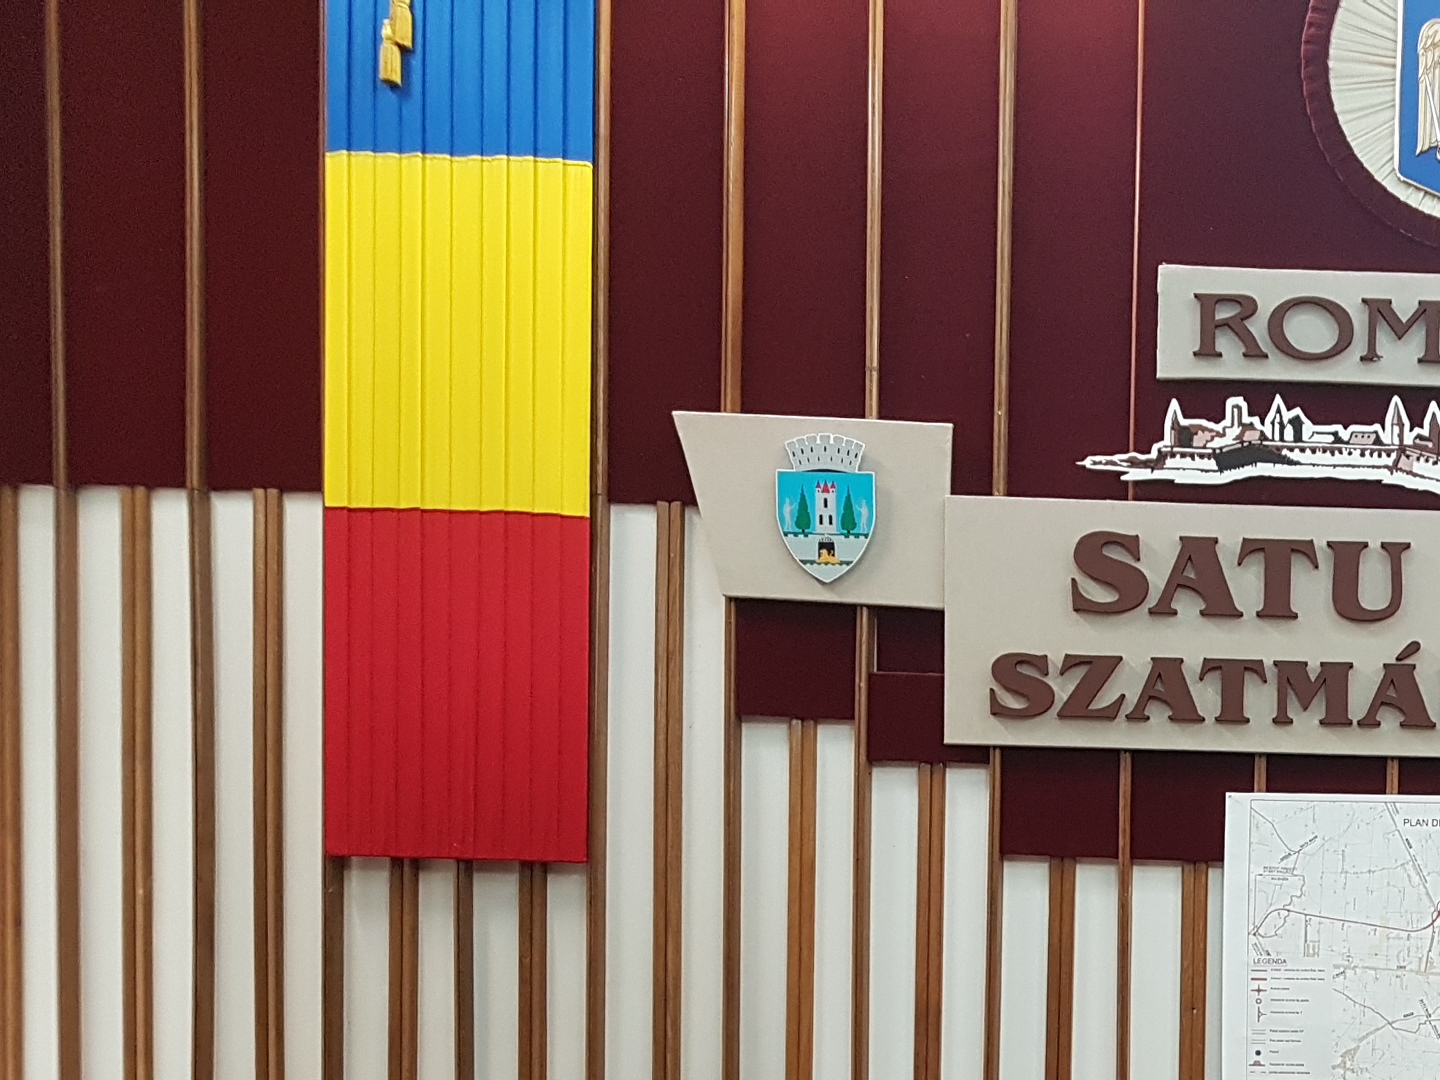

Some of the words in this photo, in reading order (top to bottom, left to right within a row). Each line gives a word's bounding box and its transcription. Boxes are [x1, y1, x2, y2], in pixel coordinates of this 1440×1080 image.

[1070, 531, 1411, 623] SATU
[1403, 818, 1429, 827] PLAN
[1253, 957, 1287, 965] LEGENDA
